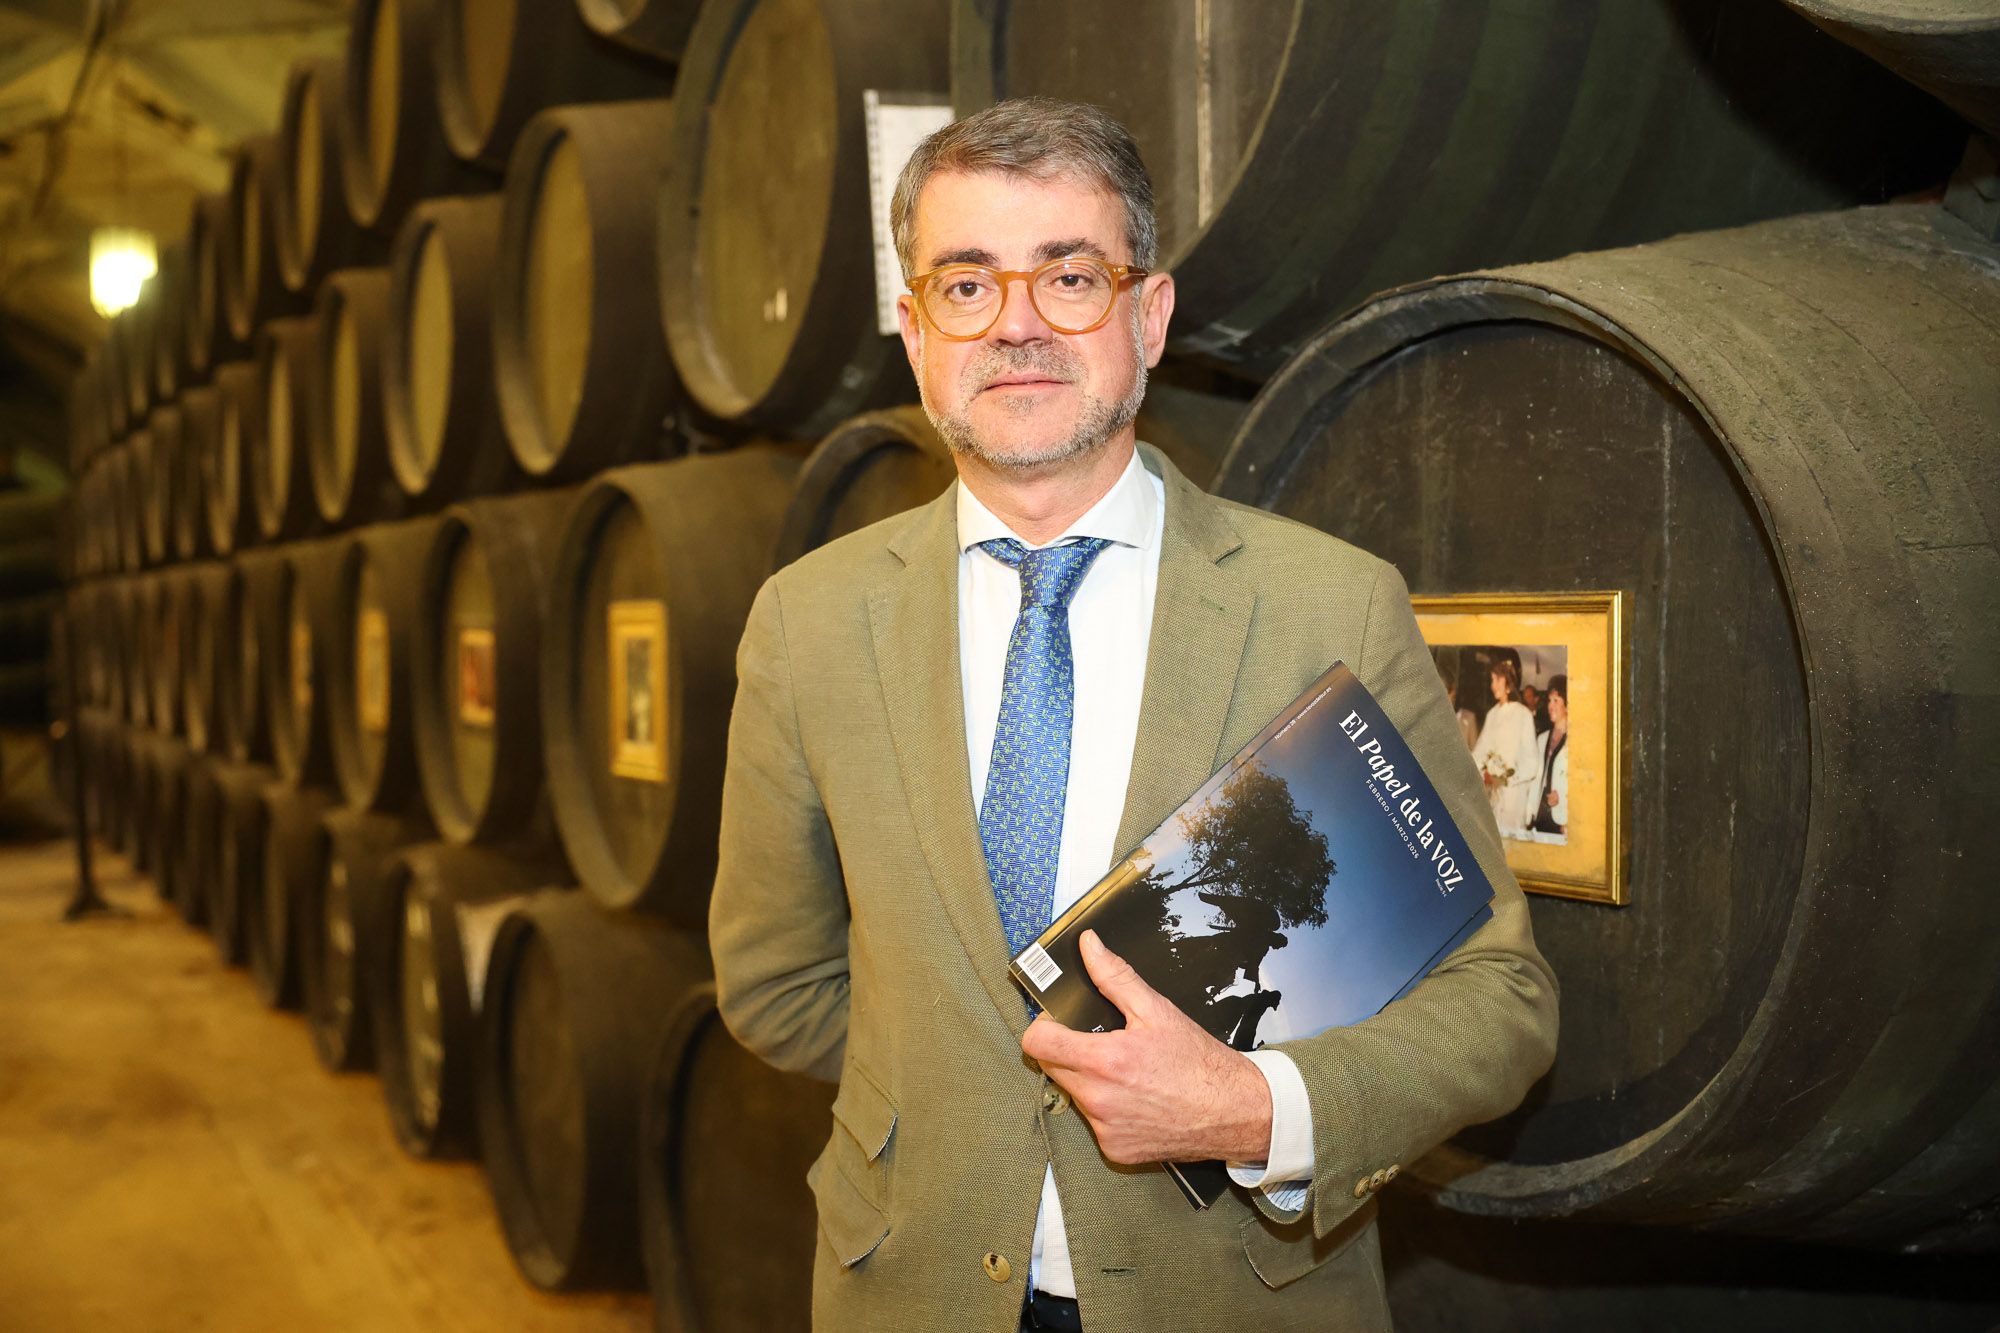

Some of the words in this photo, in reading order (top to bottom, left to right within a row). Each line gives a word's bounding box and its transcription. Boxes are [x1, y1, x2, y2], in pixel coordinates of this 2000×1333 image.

[1339, 710, 1368, 742] El
[1358, 738, 1411, 799] Papel
[1400, 797, 1421, 827] de
[1416, 819, 1434, 850] la
[1431, 840, 1464, 892] VOZ
[1366, 779, 1390, 812] FEBRERO
[1392, 817, 1409, 842] MARZO
[1407, 842, 1420, 859] 2026
